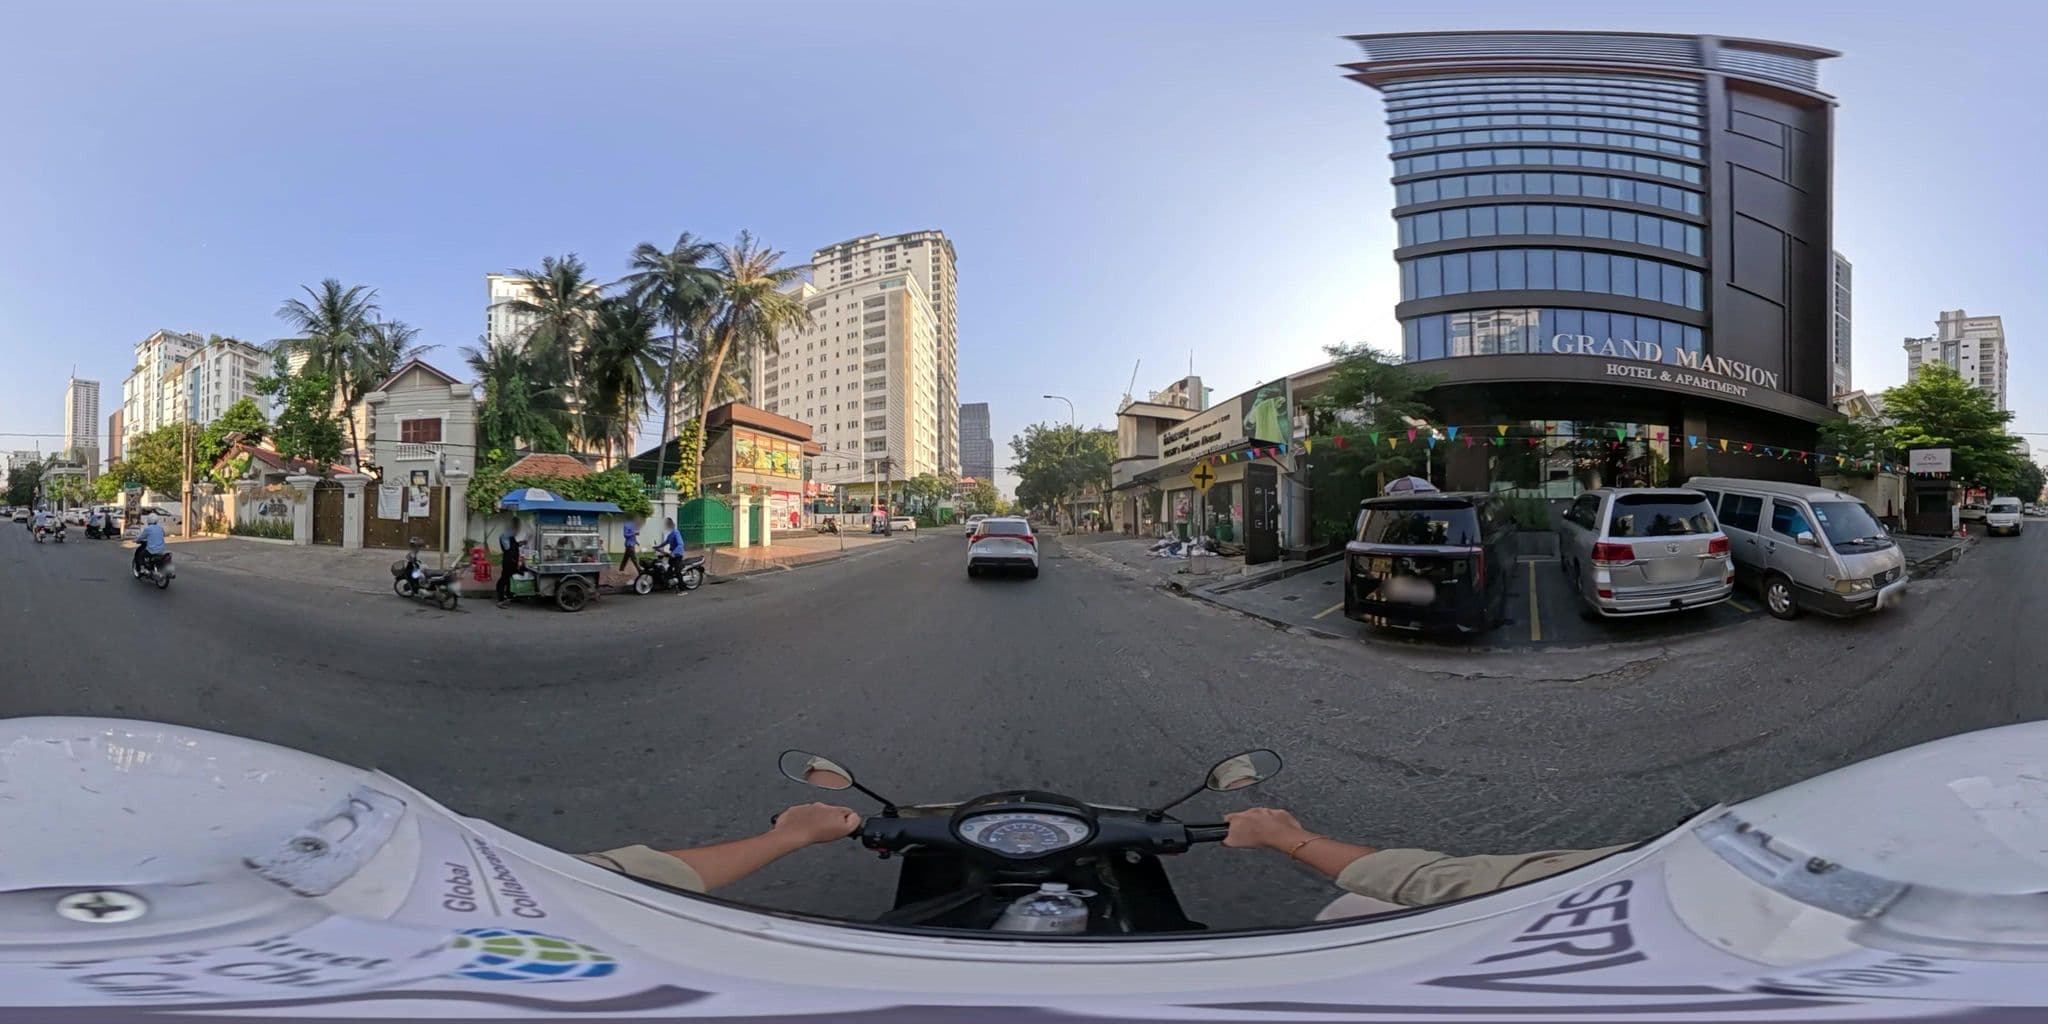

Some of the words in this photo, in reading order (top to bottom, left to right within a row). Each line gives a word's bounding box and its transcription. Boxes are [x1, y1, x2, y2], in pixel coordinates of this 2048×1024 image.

[1551, 333, 1663, 363] GRAND
[1674, 346, 1779, 391] MANSION
[1606, 363, 1658, 381] HOTEL
[1660, 370, 1673, 383] &
[1674, 372, 1749, 397] APARTMENT
[442, 861, 478, 913] Global
[473, 837, 547, 919] Collaborative
